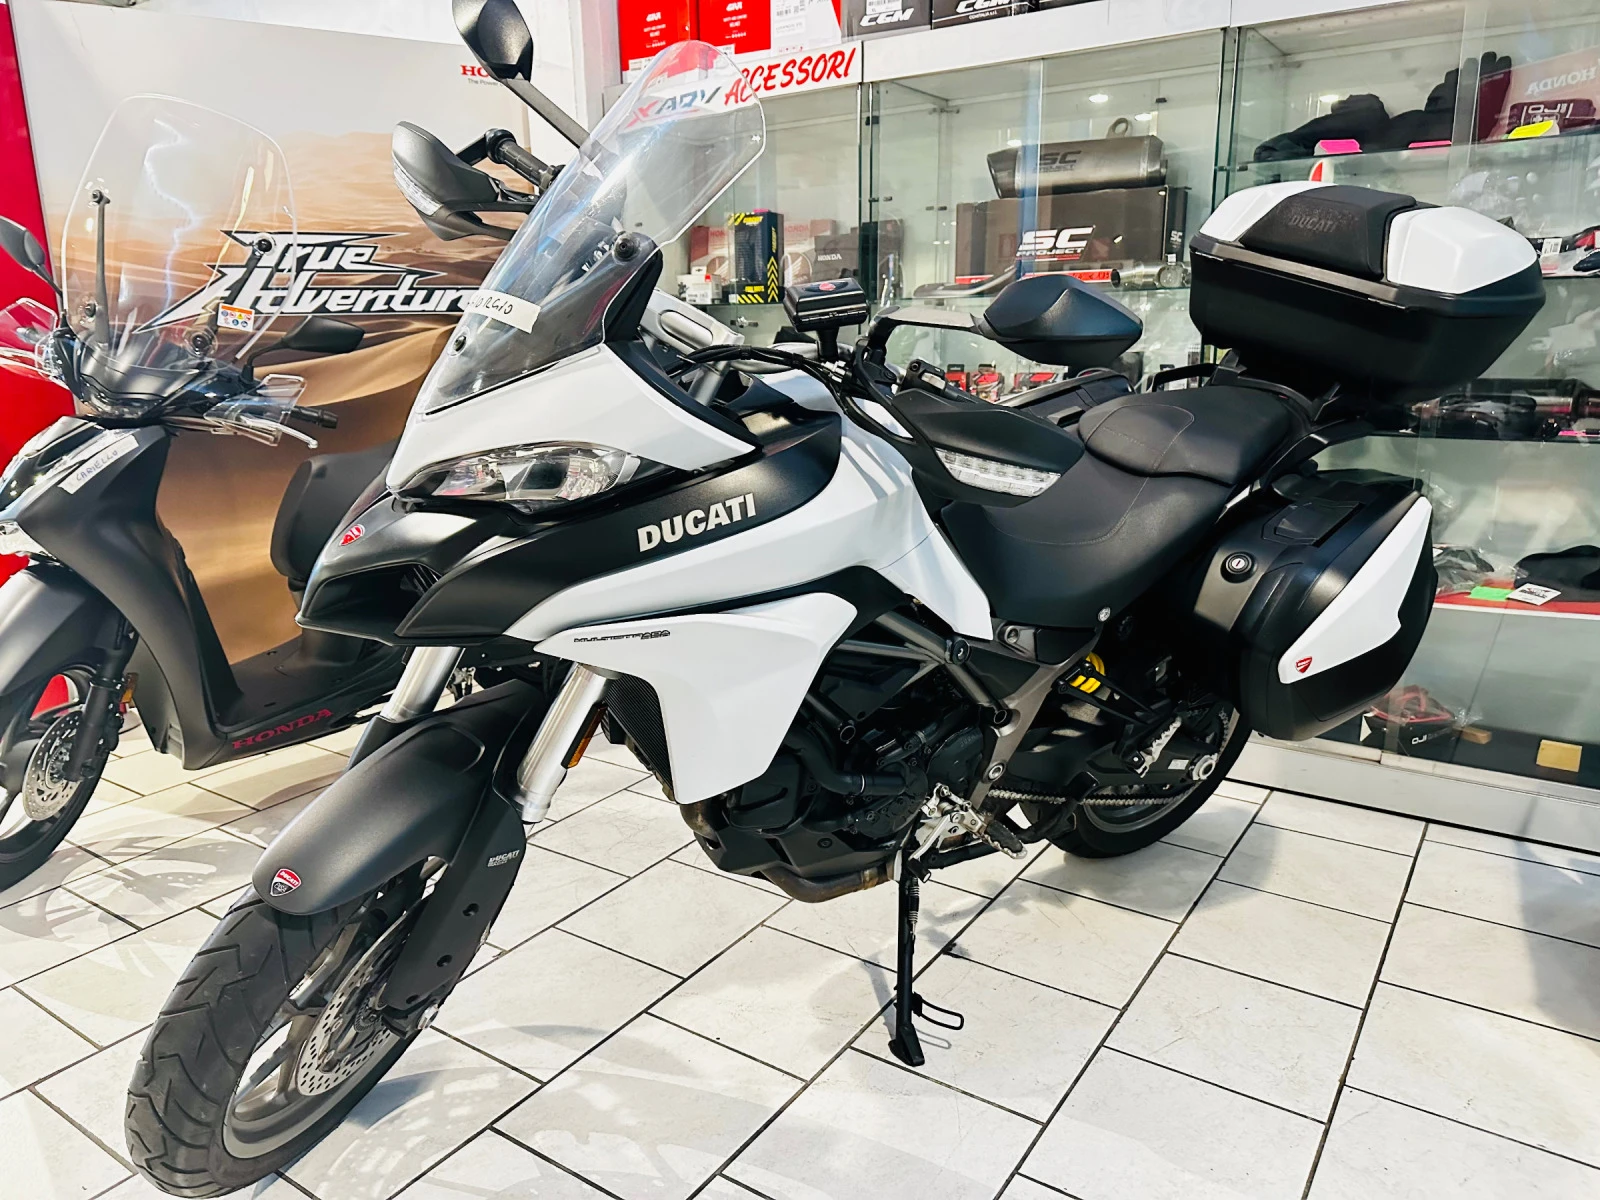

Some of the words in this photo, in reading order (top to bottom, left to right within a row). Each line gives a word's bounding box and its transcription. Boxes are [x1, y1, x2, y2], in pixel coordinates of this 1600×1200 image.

[860, 8, 914, 27] CGM
[724, 46, 858, 106] ACCESSORI
[1288, 214, 1338, 233] DUCATI
[1019, 227, 1094, 251] SC
[1170, 230, 1183, 243] SC
[817, 253, 843, 262] HONDA
[1016, 247, 1086, 257] PROJECT
[637, 493, 757, 553] DUCATI
[231, 707, 335, 750] HONDA
